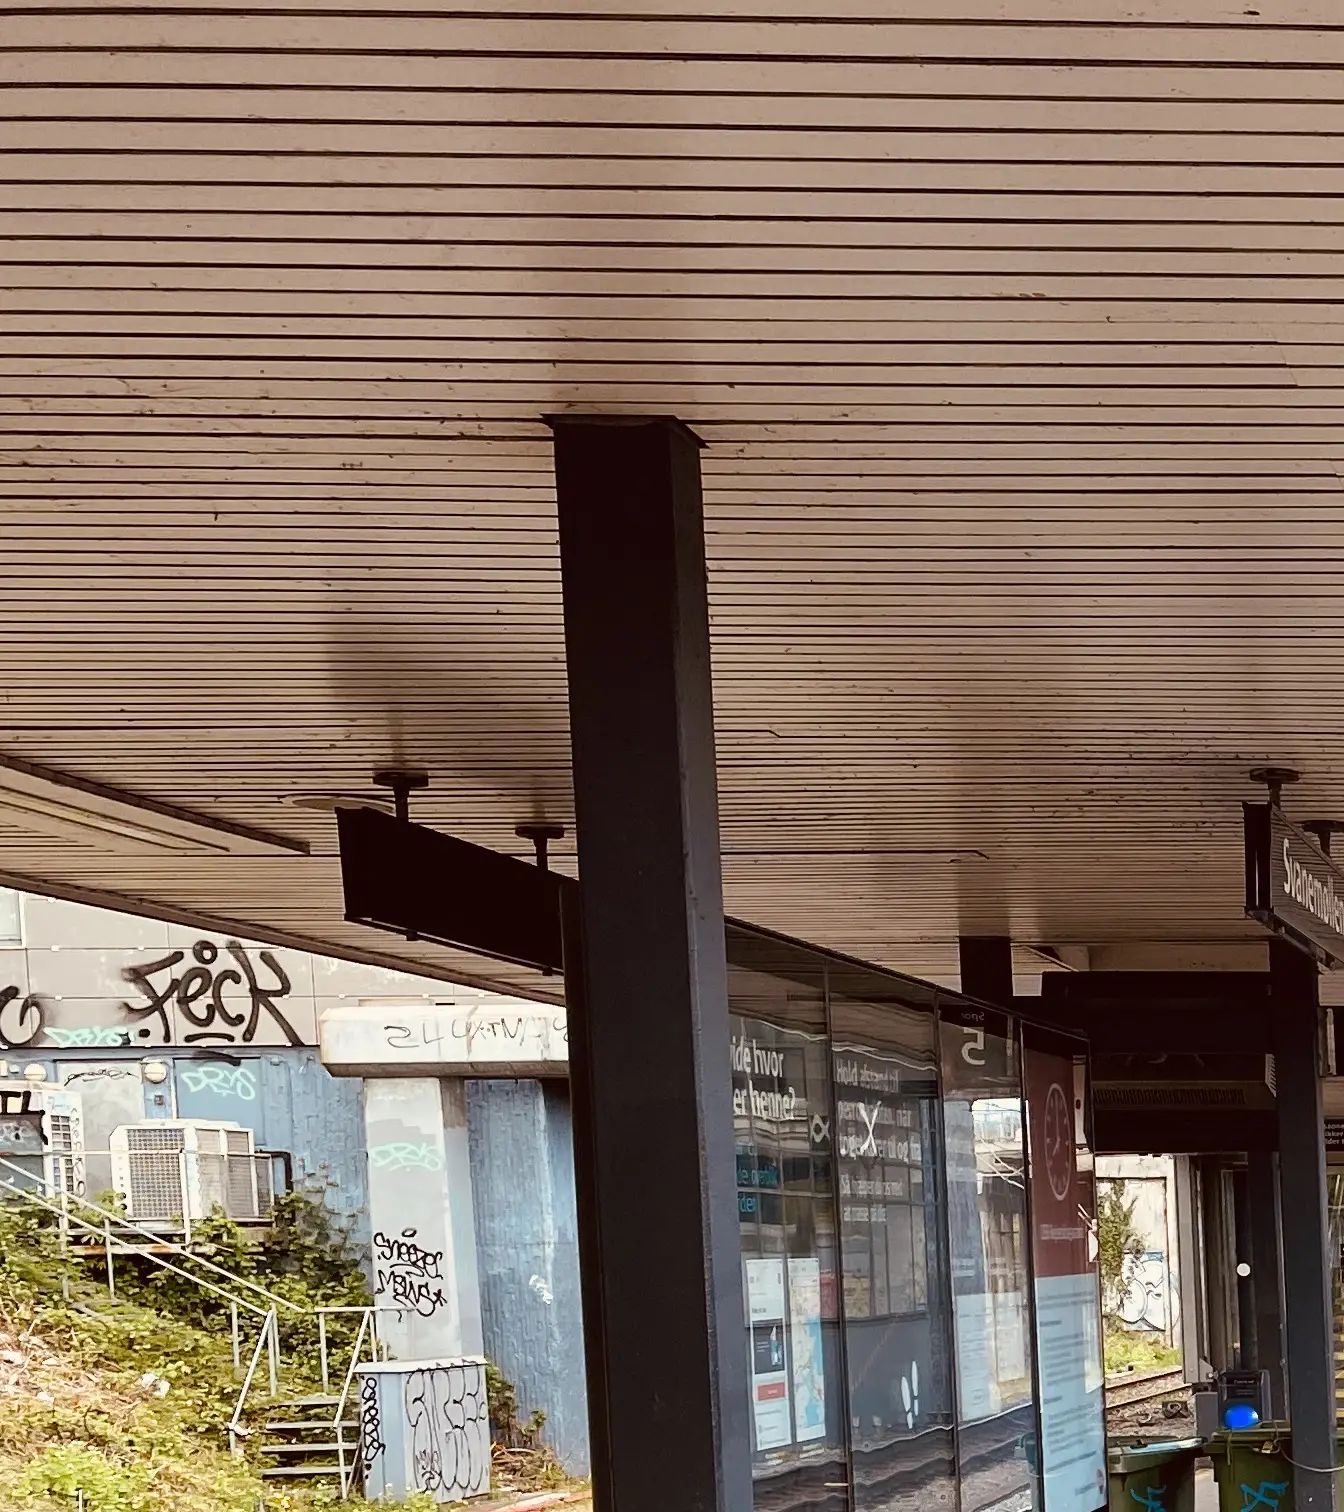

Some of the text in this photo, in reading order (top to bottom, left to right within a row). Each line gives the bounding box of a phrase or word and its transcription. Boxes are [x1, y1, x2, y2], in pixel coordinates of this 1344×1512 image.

[729, 1035, 784, 1078] ide hvor
[748, 1079, 796, 1120] henne?
